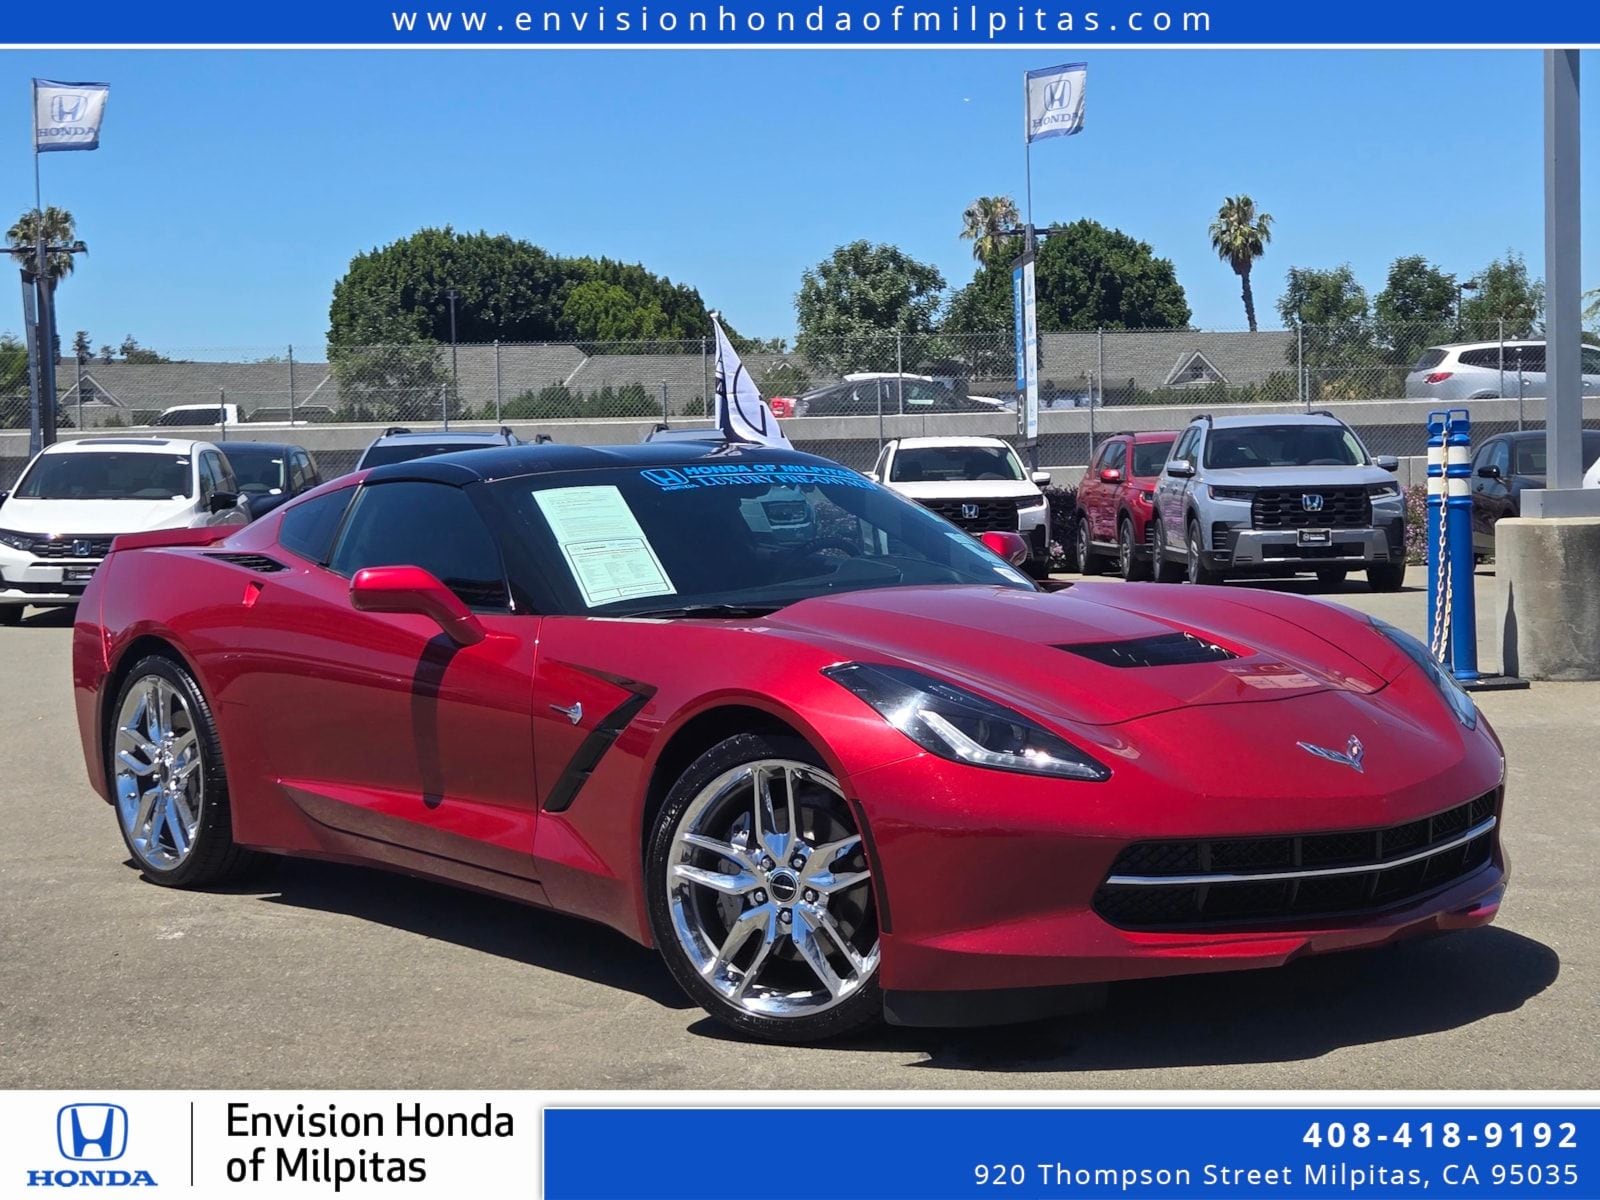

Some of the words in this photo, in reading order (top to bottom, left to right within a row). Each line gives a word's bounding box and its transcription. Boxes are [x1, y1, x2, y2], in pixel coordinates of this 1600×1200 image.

[37, 126, 97, 137] HONDA
[683, 464, 753, 475] HONDA
[753, 464, 777, 473] OF
[697, 475, 775, 487] LUXURY
